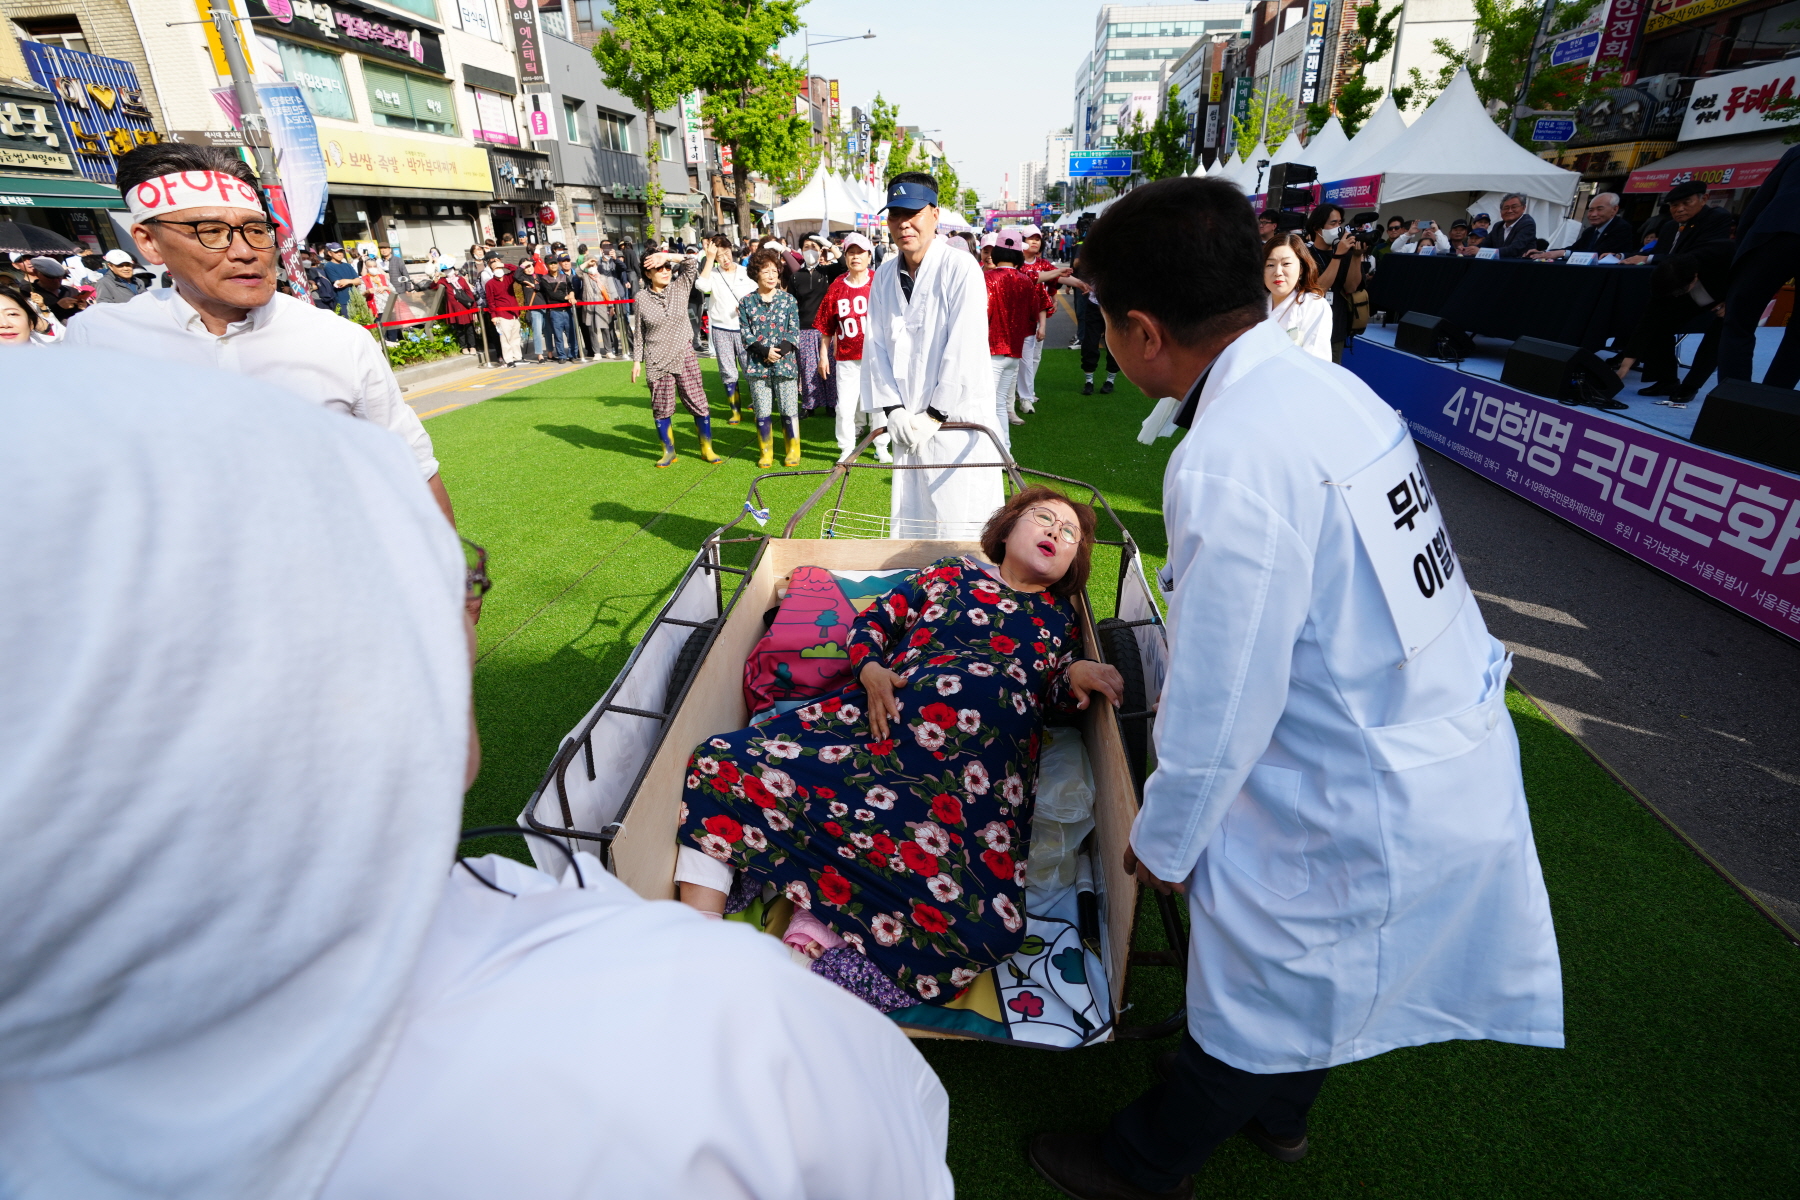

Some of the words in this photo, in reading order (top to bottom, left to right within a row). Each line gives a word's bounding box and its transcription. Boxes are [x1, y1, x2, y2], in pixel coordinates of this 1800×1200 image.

[462, 7, 487, 28] 단식원
[513, 11, 533, 24] 미원
[1309, 2, 1328, 37] 리치
[519, 26, 538, 74] 에스테틱
[1302, 39, 1323, 104] 노래주점
[535, 113, 545, 133] NAIL
[1670, 171, 1693, 187] 소주
[838, 317, 867, 341] JO
[1442, 386, 1573, 478] 4·19혁명
[1572, 428, 1800, 577] 국민문화
[1483, 457, 1501, 473] 강북구
[1505, 467, 1519, 483] 주관
[1524, 477, 1606, 527] 4·19혁명국민문화제위원회
[1614, 521, 1634, 540] 후원
[1642, 534, 1690, 567] 국가보훈부
[1692, 561, 1749, 597] 서울특별시
